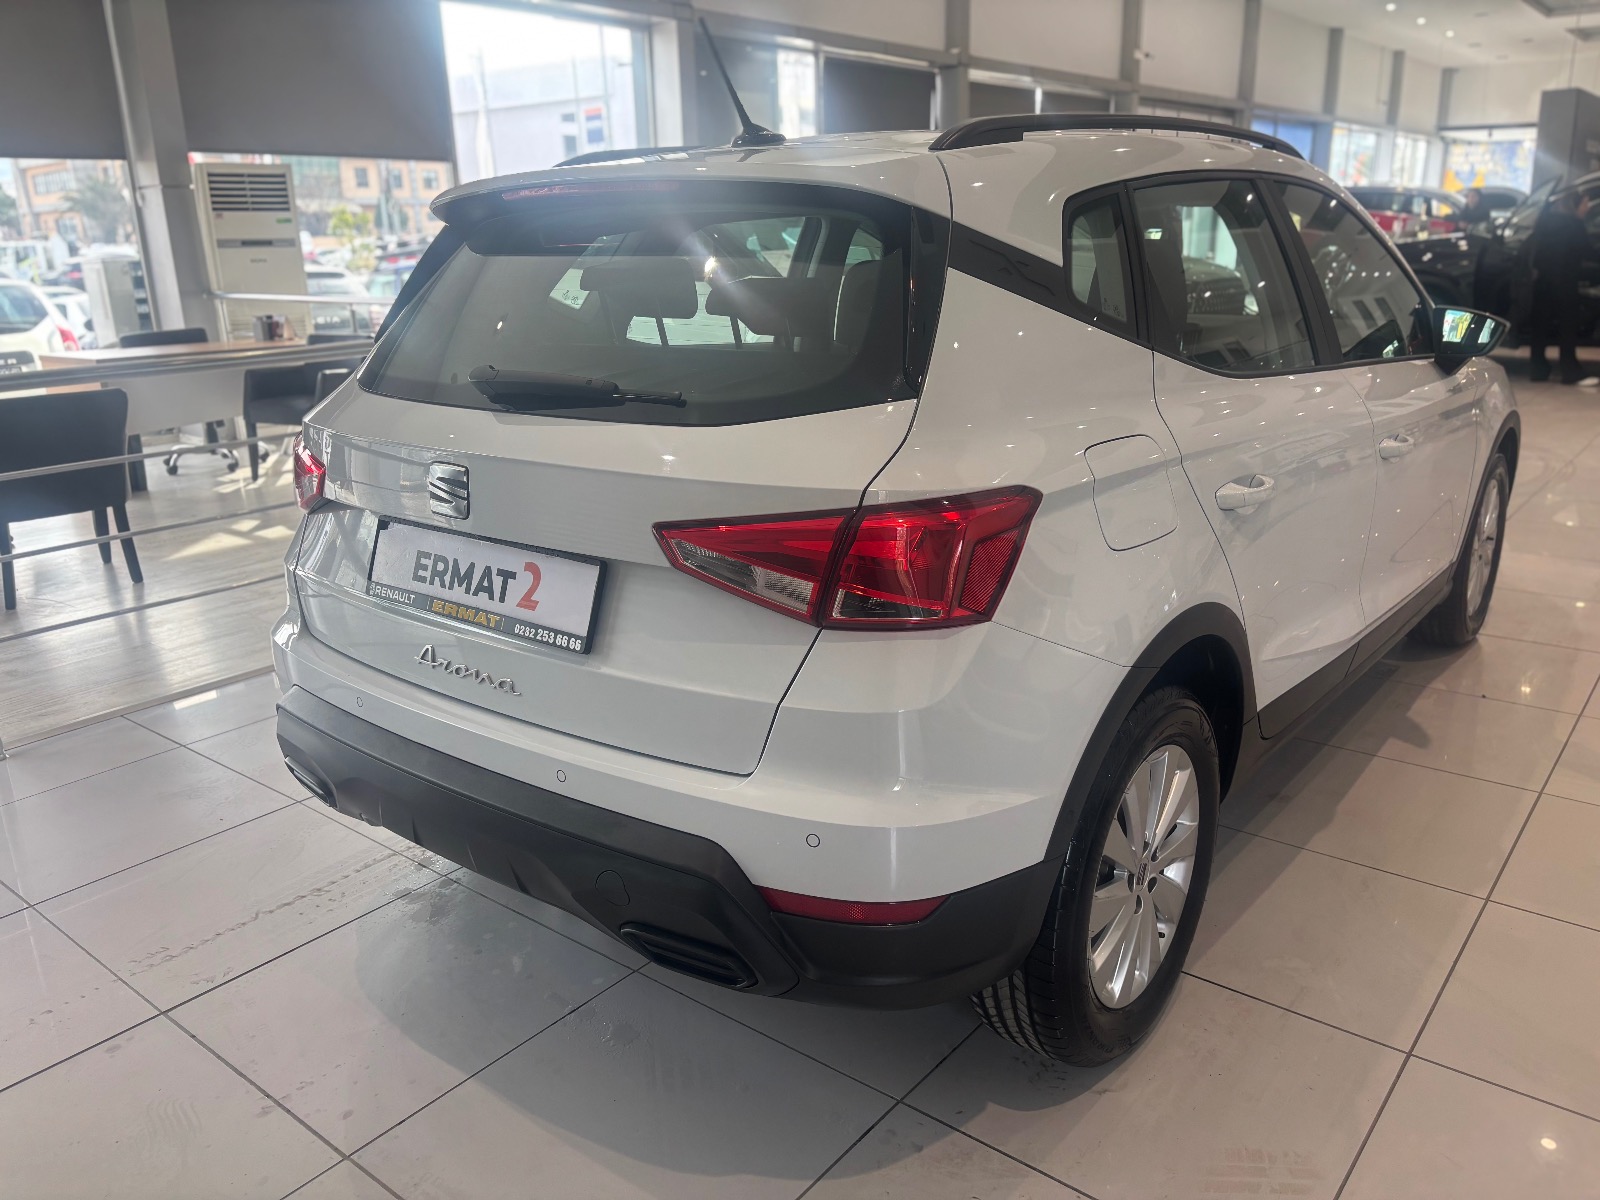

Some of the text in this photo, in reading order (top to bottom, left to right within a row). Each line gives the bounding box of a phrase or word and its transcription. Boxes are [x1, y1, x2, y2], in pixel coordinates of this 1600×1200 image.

[375, 585, 415, 604] RENAULT
[432, 599, 501, 628] ERMAT
[514, 624, 582, 651] 0232 253 66 66
[414, 644, 521, 695] Arona
